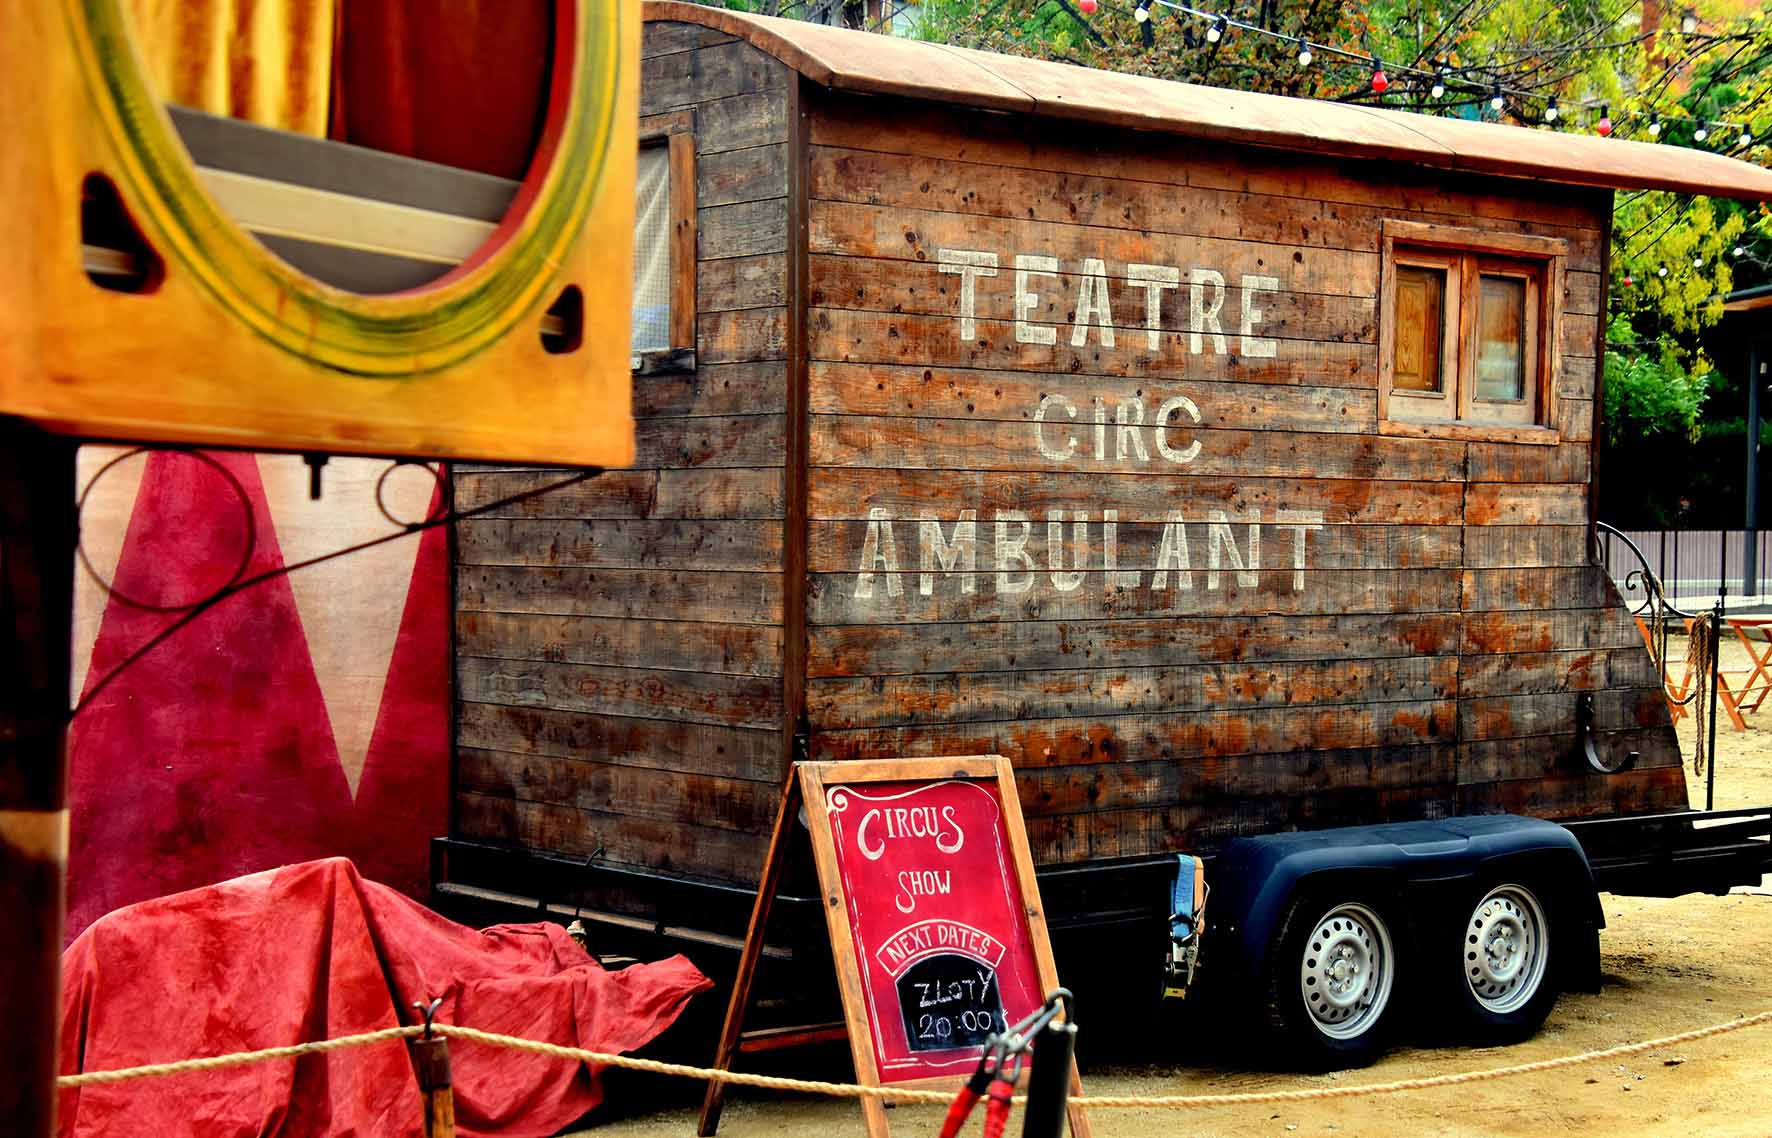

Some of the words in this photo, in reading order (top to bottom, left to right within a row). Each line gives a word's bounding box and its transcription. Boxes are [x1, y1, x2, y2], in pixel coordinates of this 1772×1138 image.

[938, 249, 1279, 358] TEATRE
[1034, 394, 1203, 463] CIRC
[854, 508, 1324, 599] AMBULANT
[857, 806, 964, 860] CIRCUS
[895, 870, 951, 913] SHOW
[888, 926, 932, 962] NEXT
[937, 925, 991, 955] DATES
